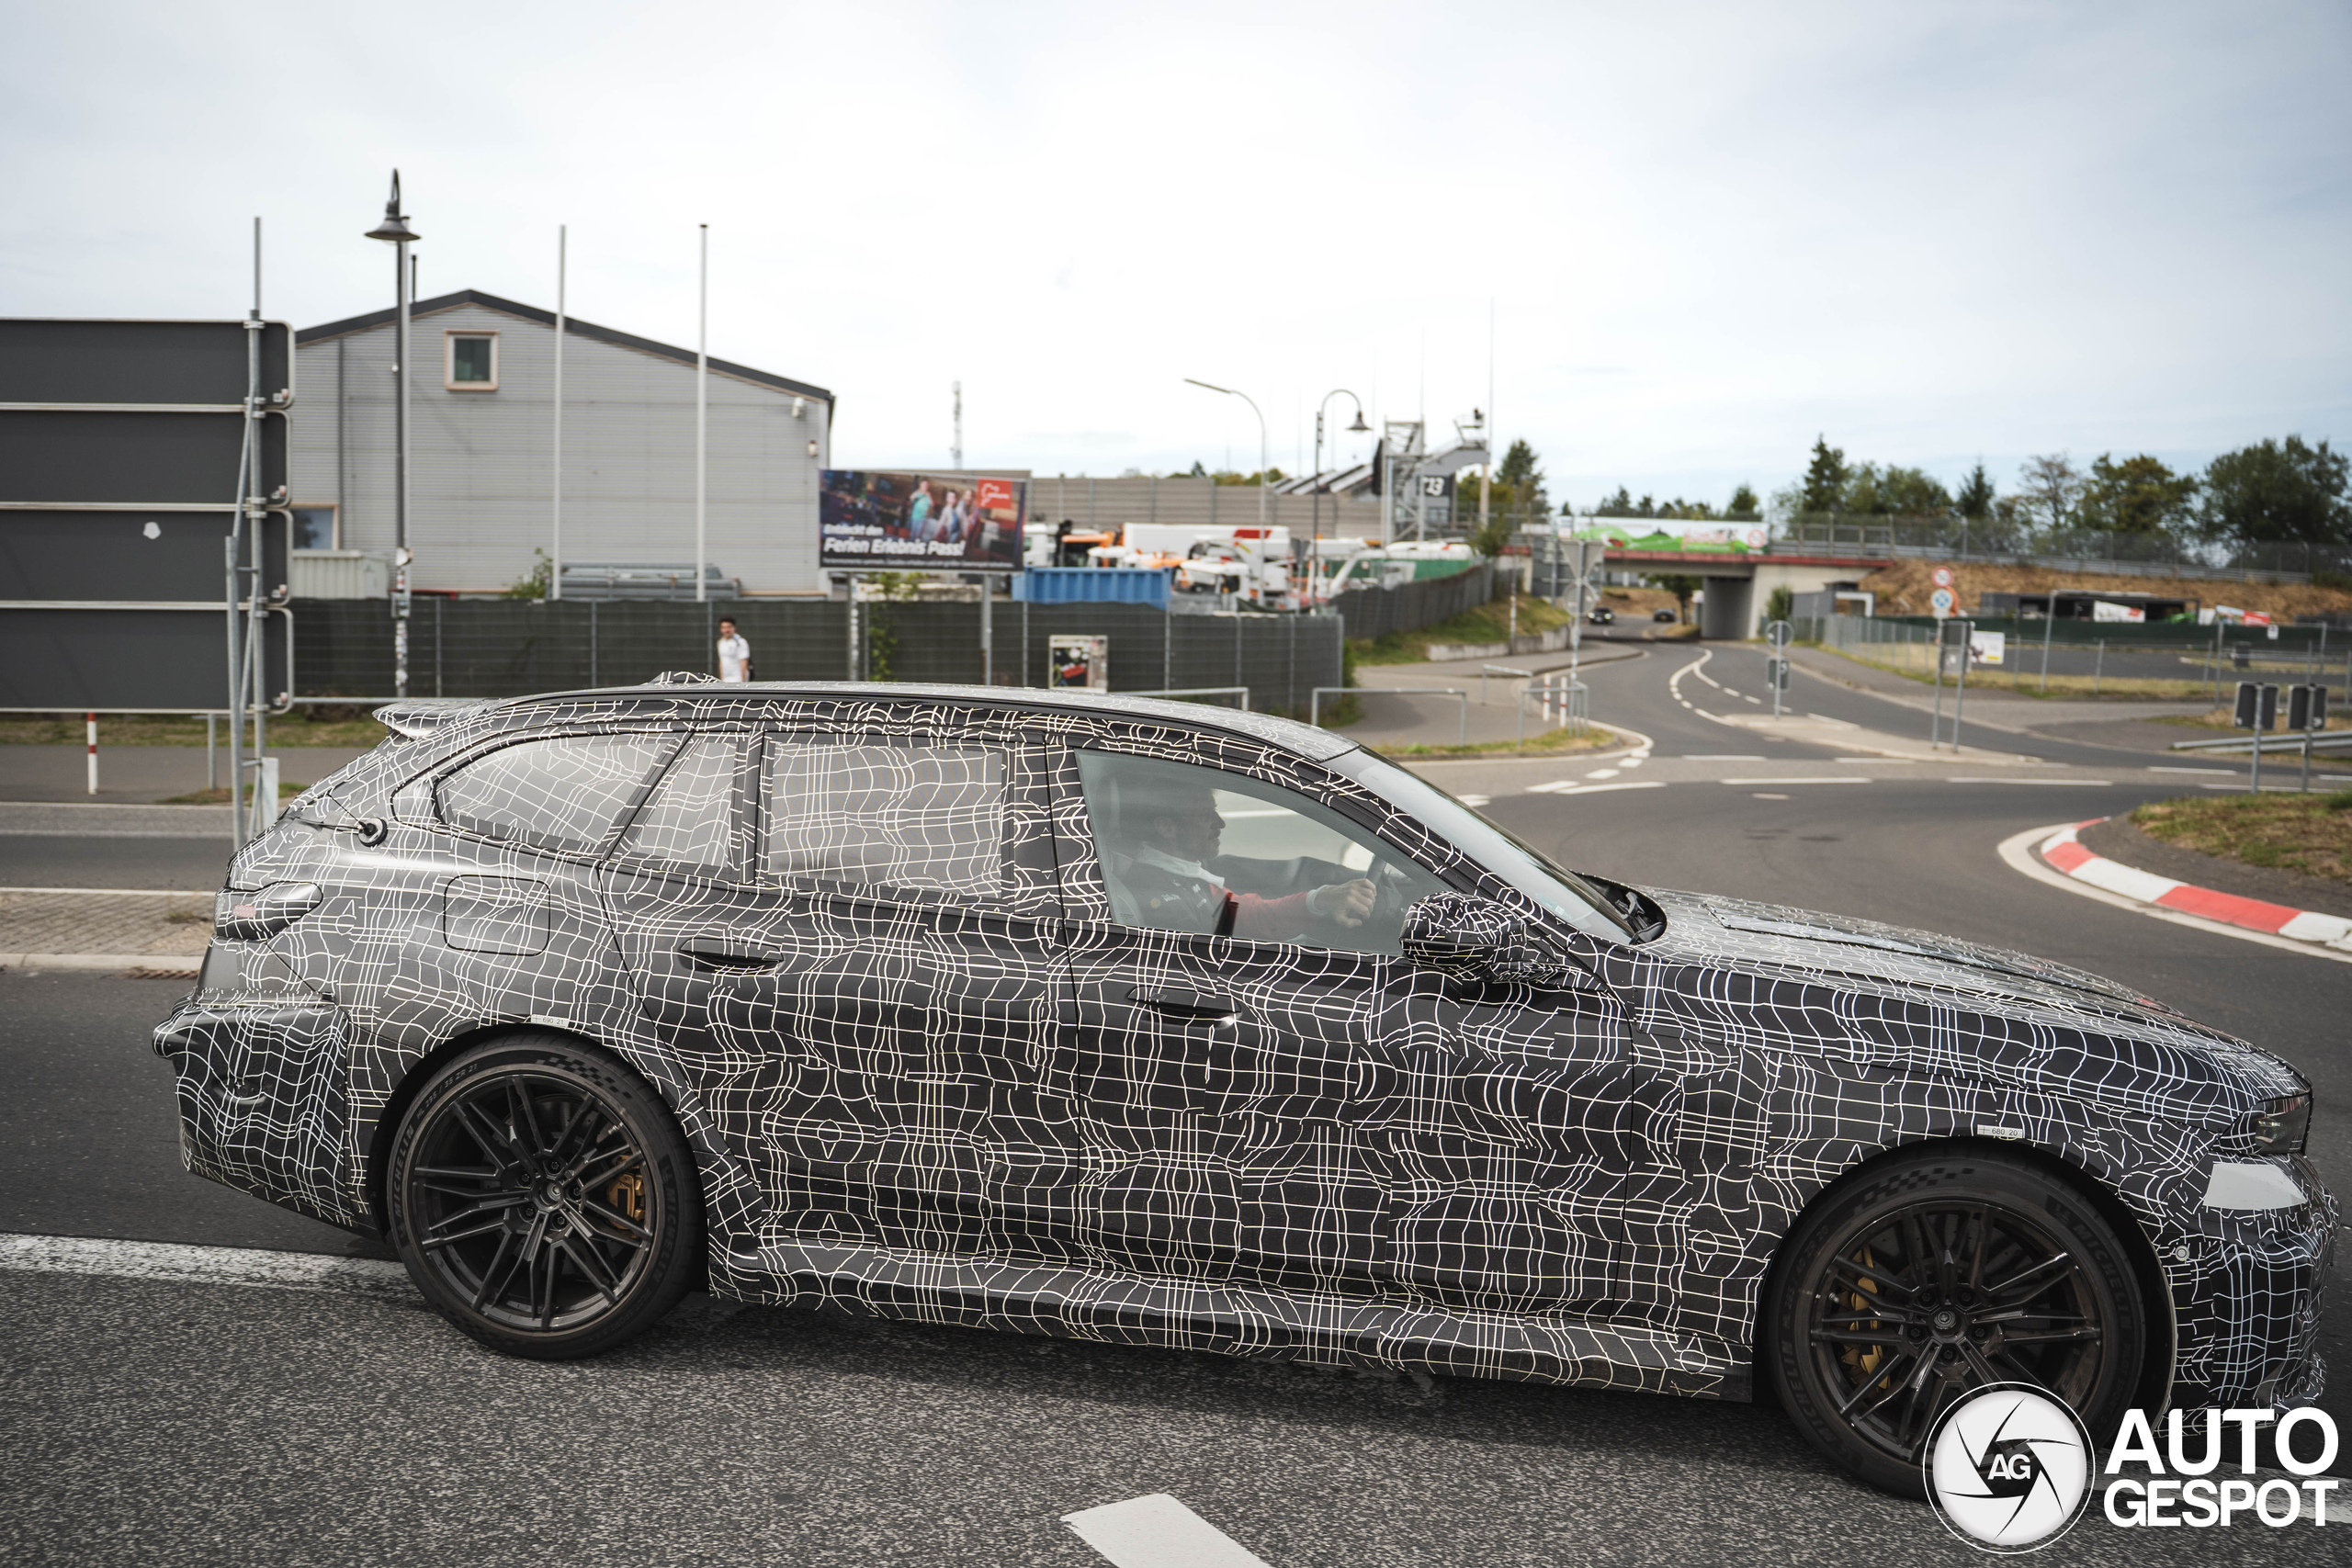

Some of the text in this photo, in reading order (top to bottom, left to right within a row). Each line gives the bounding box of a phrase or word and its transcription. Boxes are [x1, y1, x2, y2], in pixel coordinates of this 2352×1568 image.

[823, 536, 966, 556] Ferien Erlebnis Pass!
[392, 1125, 414, 1219] MICHELIN
[651, 1187, 677, 1282] MICHELIN
[2073, 1224, 2132, 1330] MICHELIN
[1781, 1339, 1838, 1442] MICHELIN
